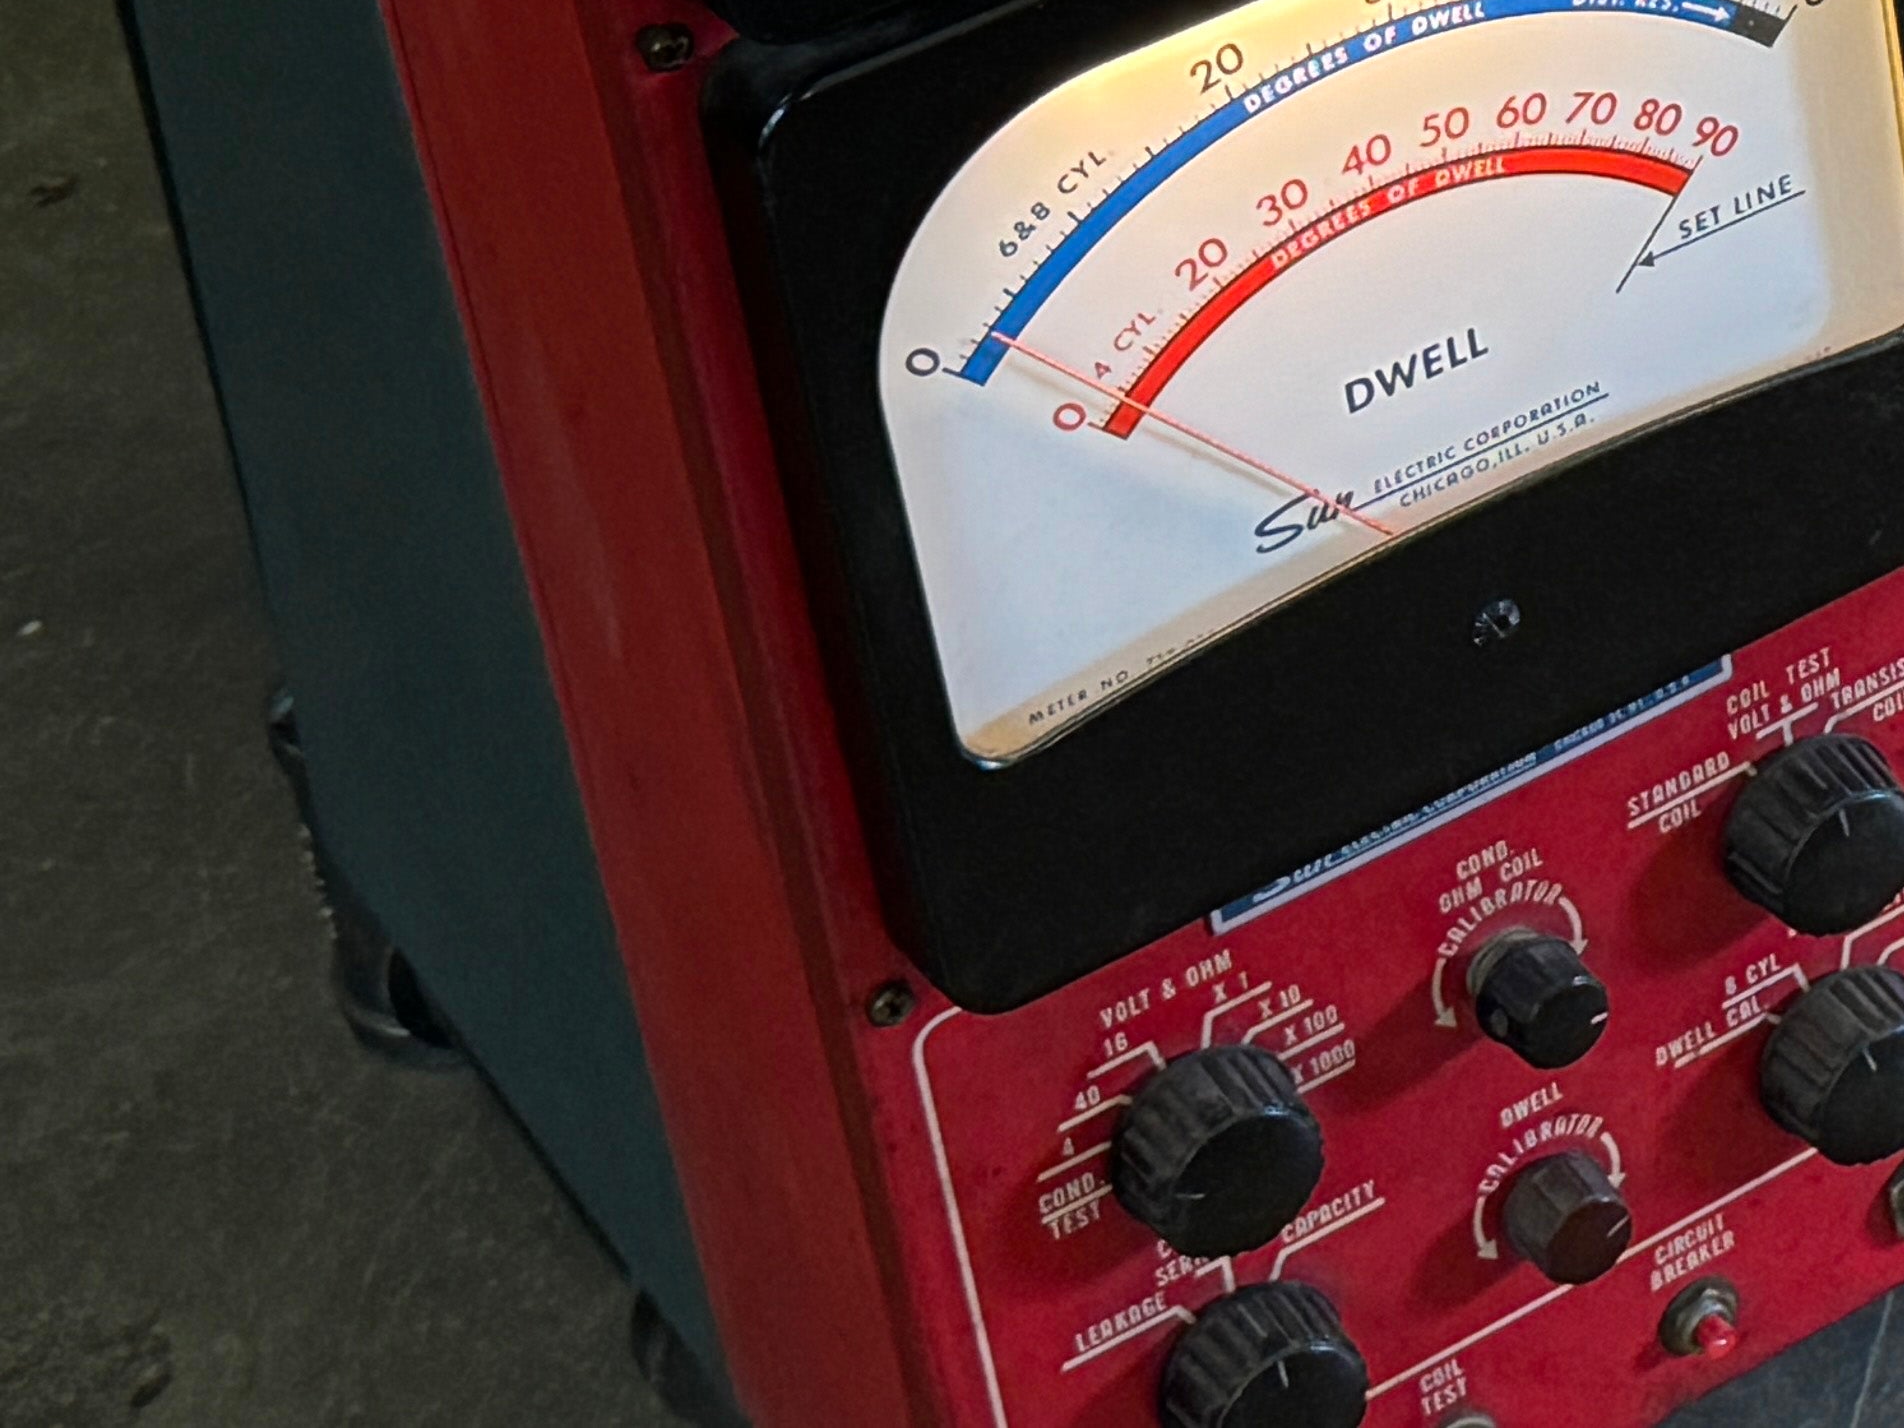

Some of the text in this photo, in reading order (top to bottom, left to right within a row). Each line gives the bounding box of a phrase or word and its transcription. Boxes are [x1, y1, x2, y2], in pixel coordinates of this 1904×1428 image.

[1242, 1, 1485, 116] DEGREES OF DWELL
[904, 346, 941, 378] 0
[1189, 42, 1245, 94] 20
[998, 201, 1052, 259] 6&8
[1678, 173, 1793, 241] SET LINE
[1052, 91, 1739, 432] 0 20 30 40 50 60 70 80 90
[1344, 328, 1490, 415] DWELL
[1726, 647, 1831, 716] COIL TEST
[1627, 750, 1731, 818] STANDARD
[1657, 802, 1701, 834] COIL
[1100, 948, 1234, 1031] VOLT & OHM
[1500, 1080, 1565, 1129] DWELL
[1280, 1179, 1376, 1244] CAPACITY
[1074, 1291, 1166, 1355] LEAKAGE
